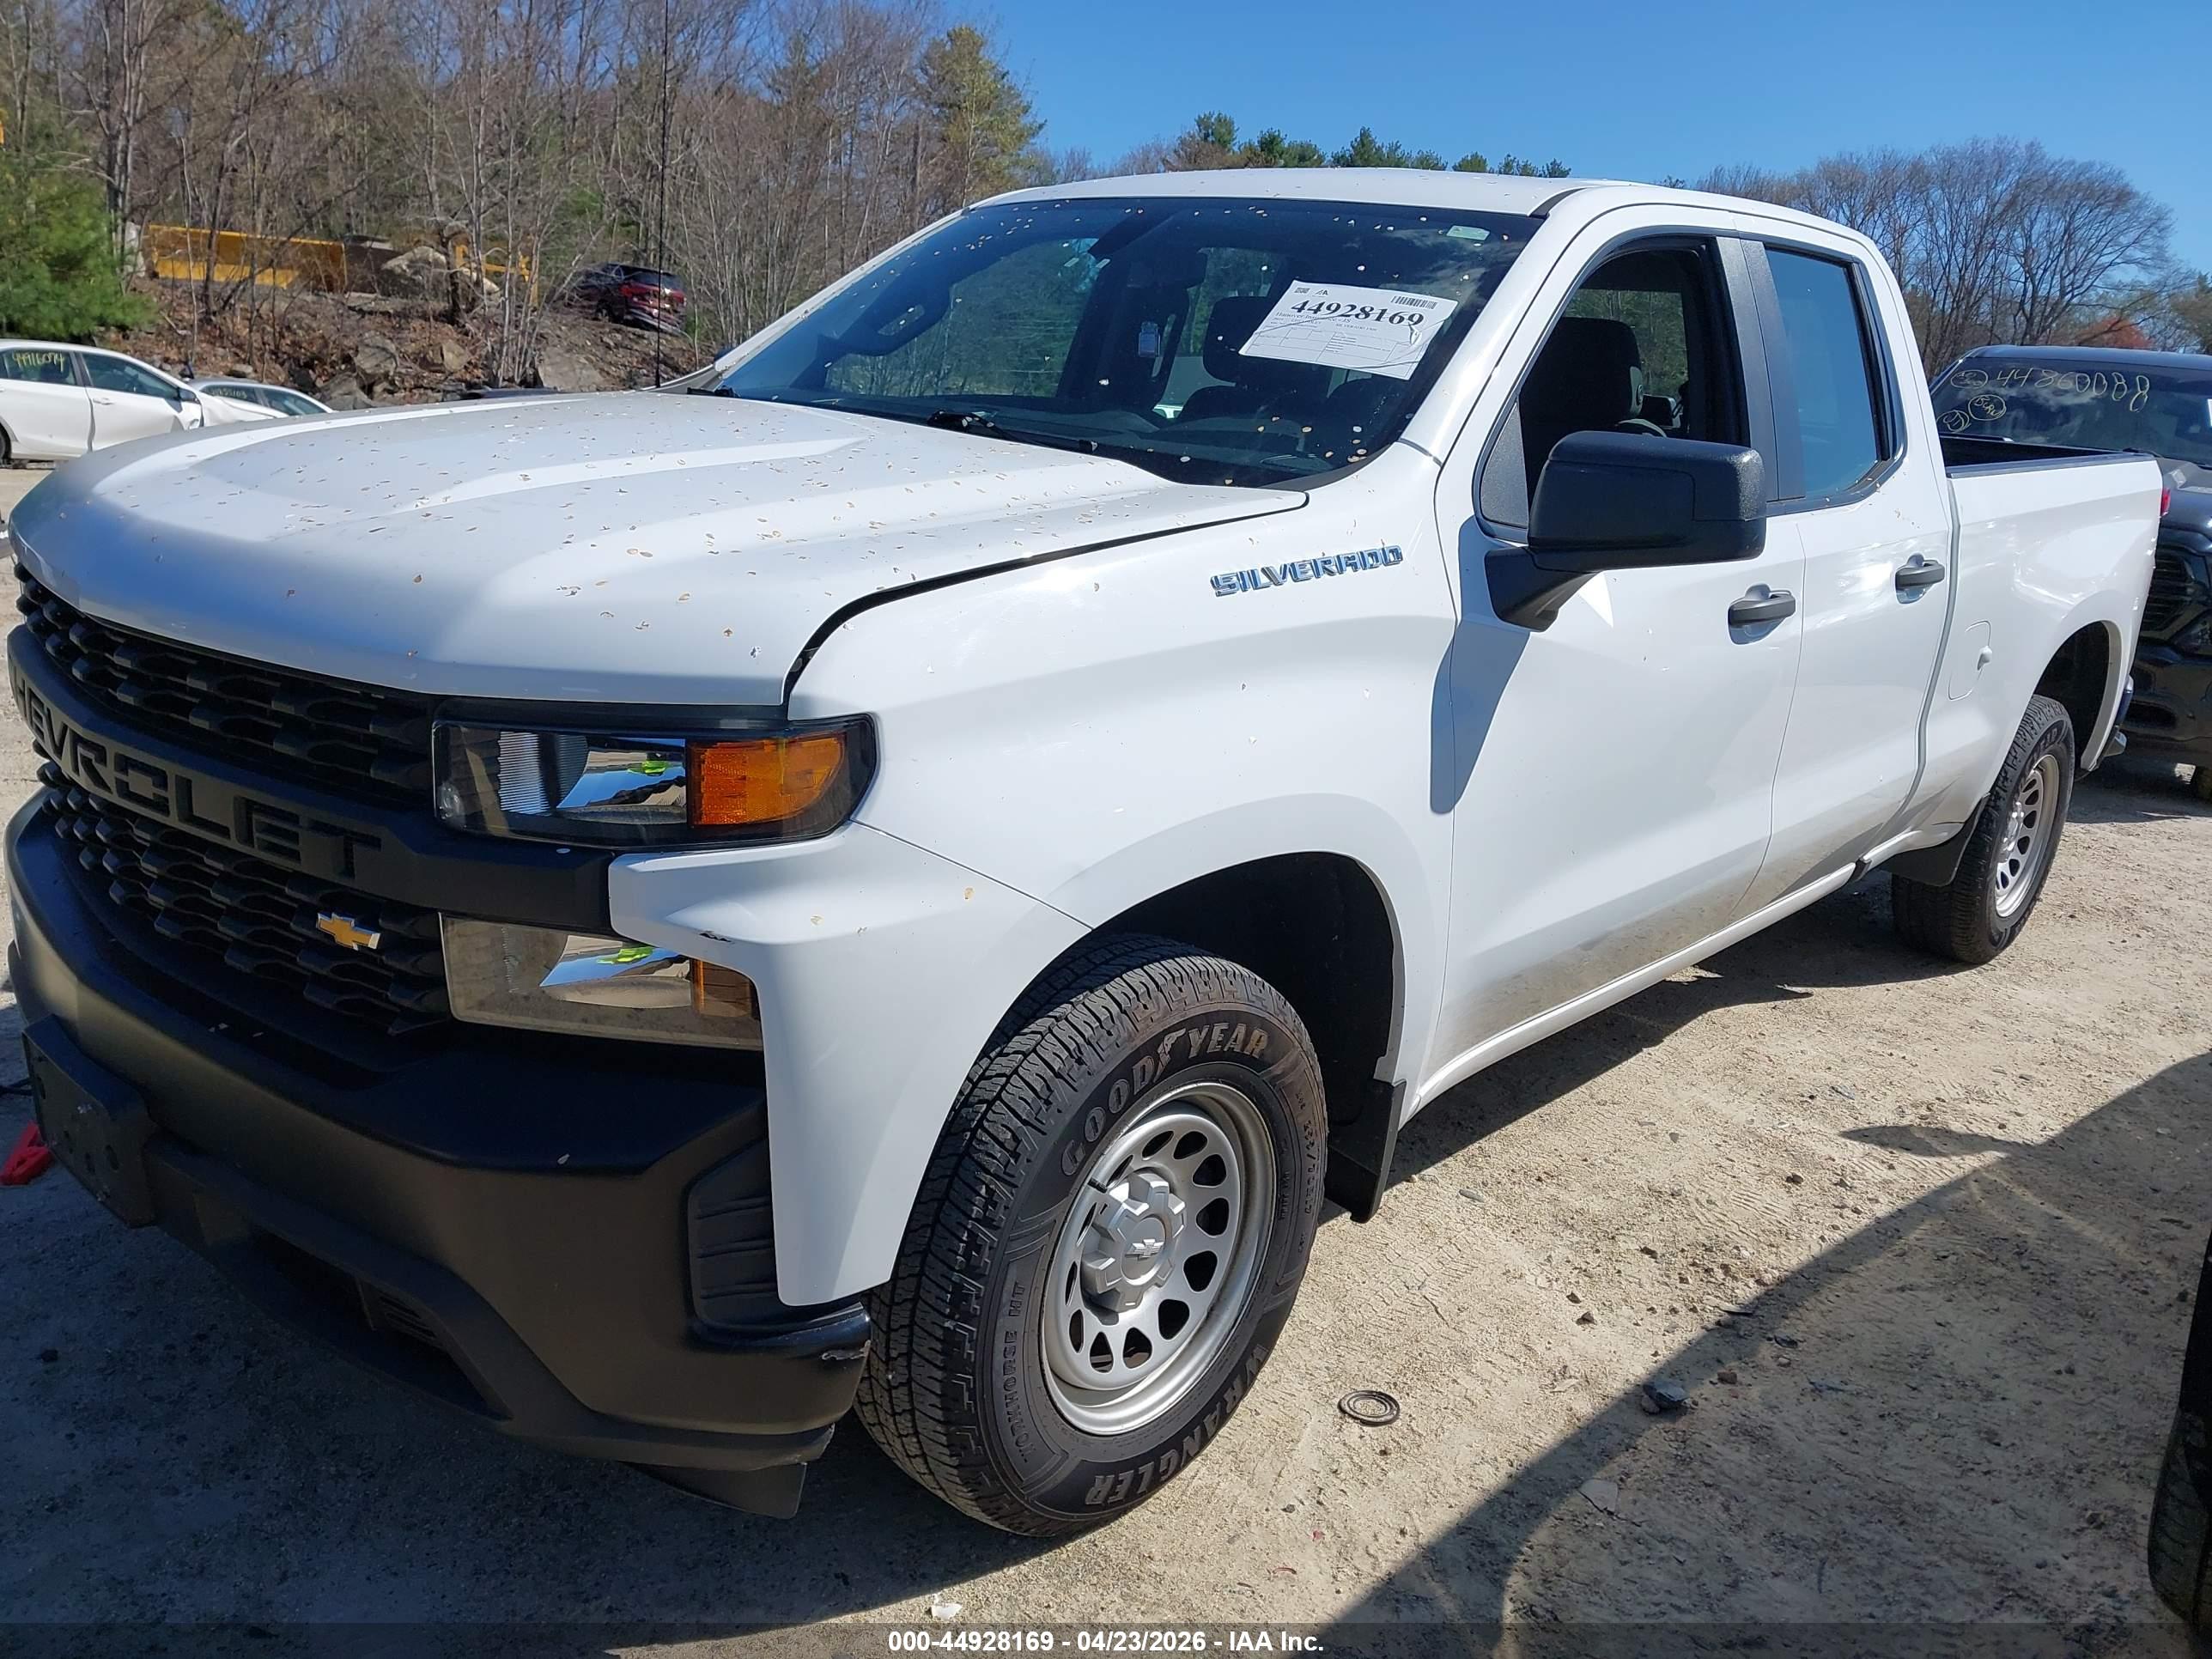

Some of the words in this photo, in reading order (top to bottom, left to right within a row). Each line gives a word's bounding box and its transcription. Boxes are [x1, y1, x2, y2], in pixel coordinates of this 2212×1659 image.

[1291, 299, 1425, 326] 44928169
[1210, 545, 1404, 598] SILVERADO
[9, 664, 383, 879] HEVROLET
[1061, 1022, 1269, 1176] GOODYEAR
[1085, 1344, 1269, 1505] WRANGLER
